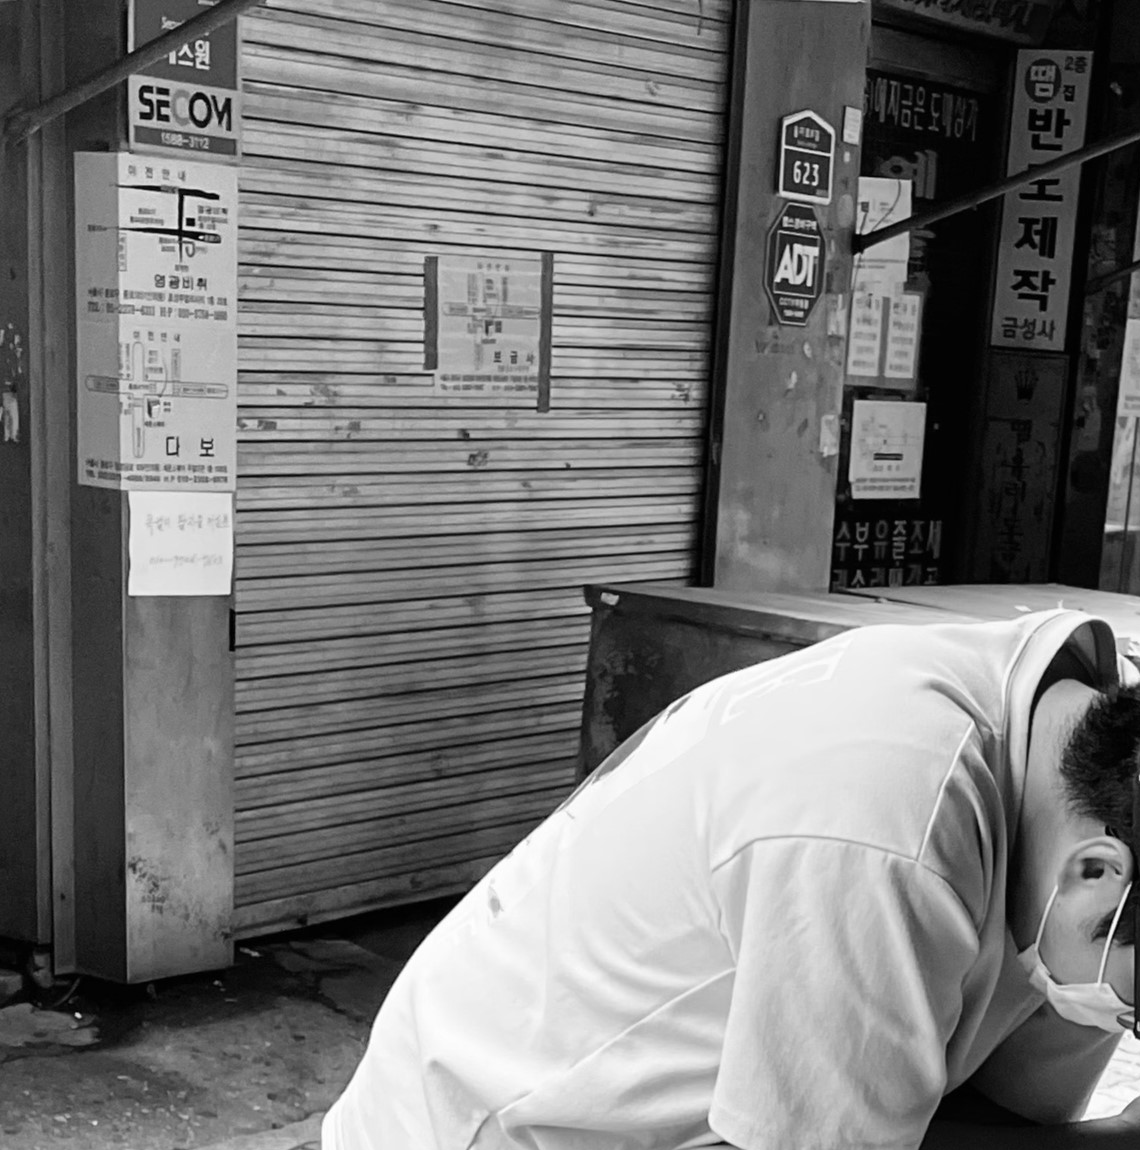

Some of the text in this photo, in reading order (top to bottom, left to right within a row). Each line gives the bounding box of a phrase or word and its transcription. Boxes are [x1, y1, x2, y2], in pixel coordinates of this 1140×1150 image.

[138, 84, 232, 132] SECOM
[792, 160, 820, 187] 623
[774, 243, 820, 287] ADT
[1001, 316, 1056, 342] 금성사
[166, 436, 215, 458] 다보
